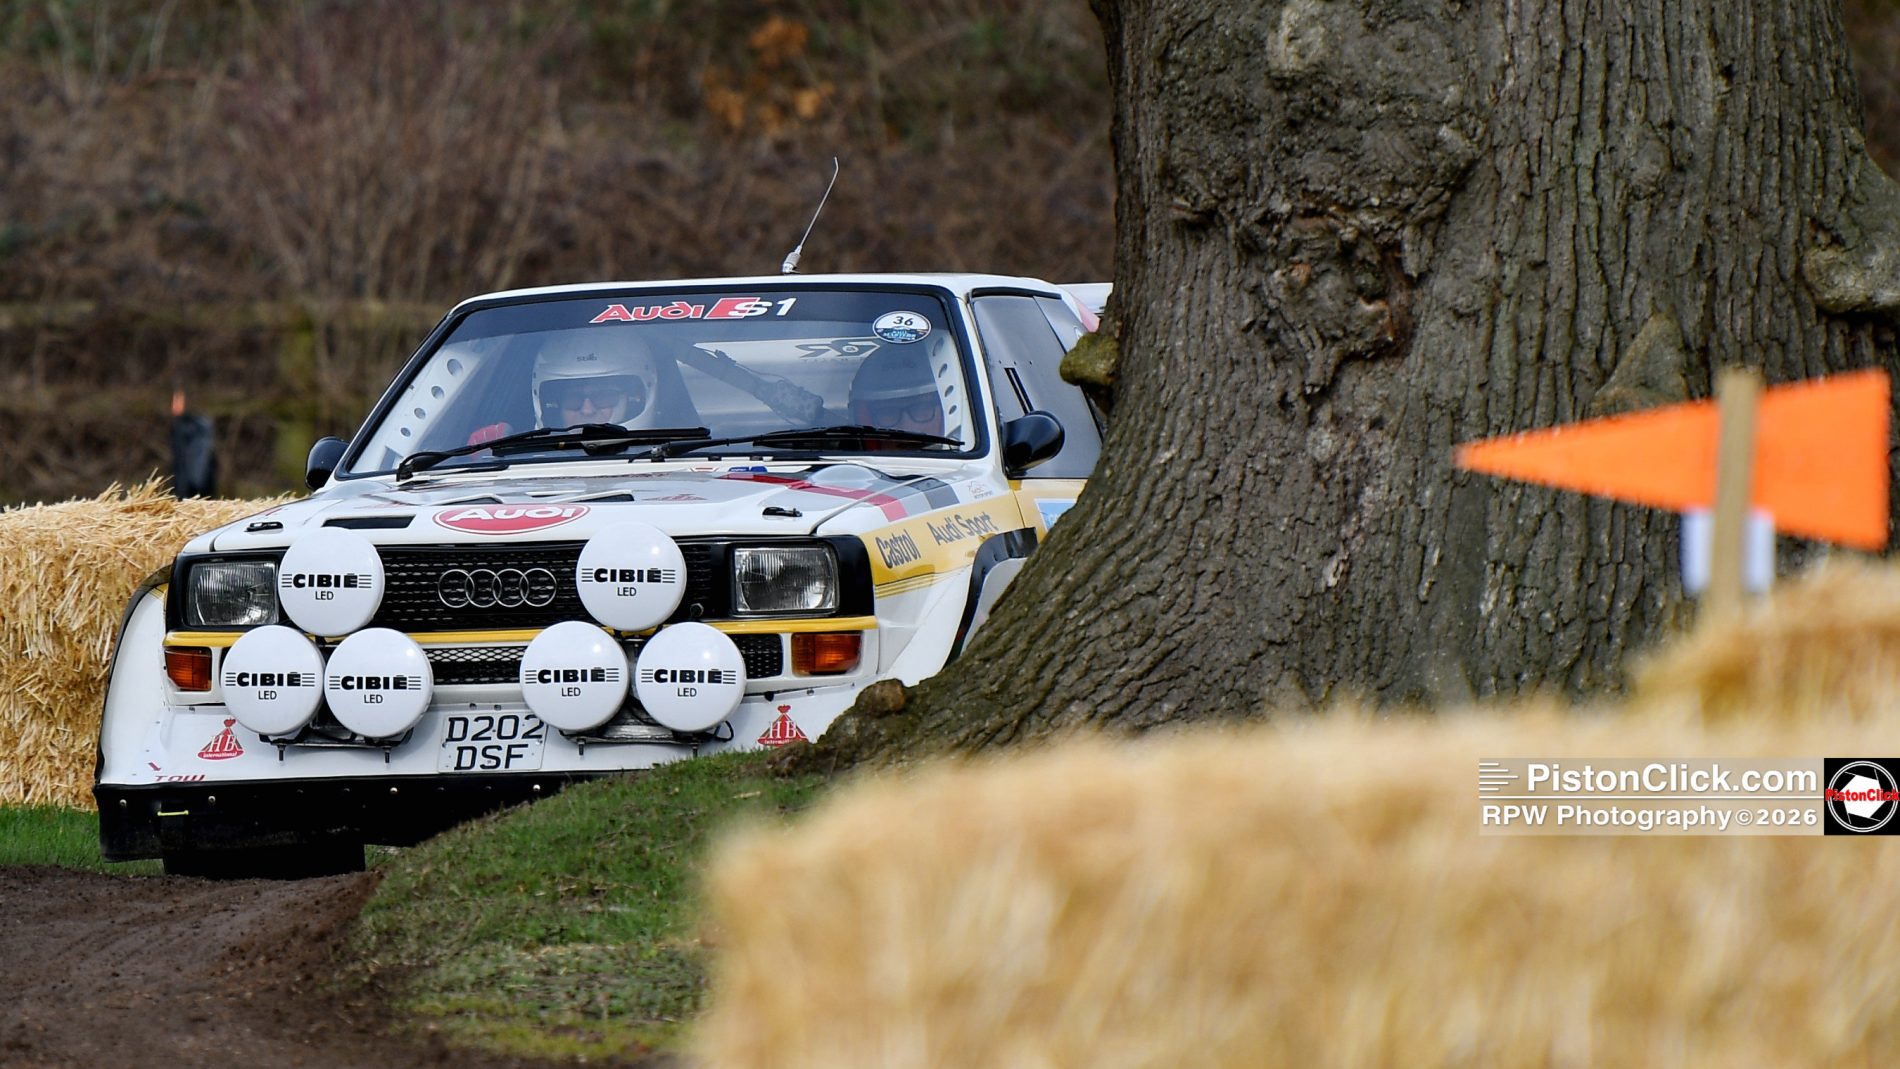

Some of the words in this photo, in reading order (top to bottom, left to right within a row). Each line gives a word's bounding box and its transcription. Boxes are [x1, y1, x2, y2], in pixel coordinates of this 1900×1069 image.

[892, 315, 914, 326] 36
[926, 516, 966, 546] Audi
[954, 511, 999, 537] Sport
[875, 529, 922, 569] Castrol
[315, 590, 334, 601] LED
[617, 586, 637, 597] LED
[258, 690, 277, 700] LED
[561, 687, 581, 697] LED
[677, 687, 697, 697] LED
[363, 694, 383, 704] LED
[445, 714, 545, 743] D202
[770, 720, 797, 739] HB
[207, 734, 237, 752] HB
[453, 743, 529, 771] DSF
